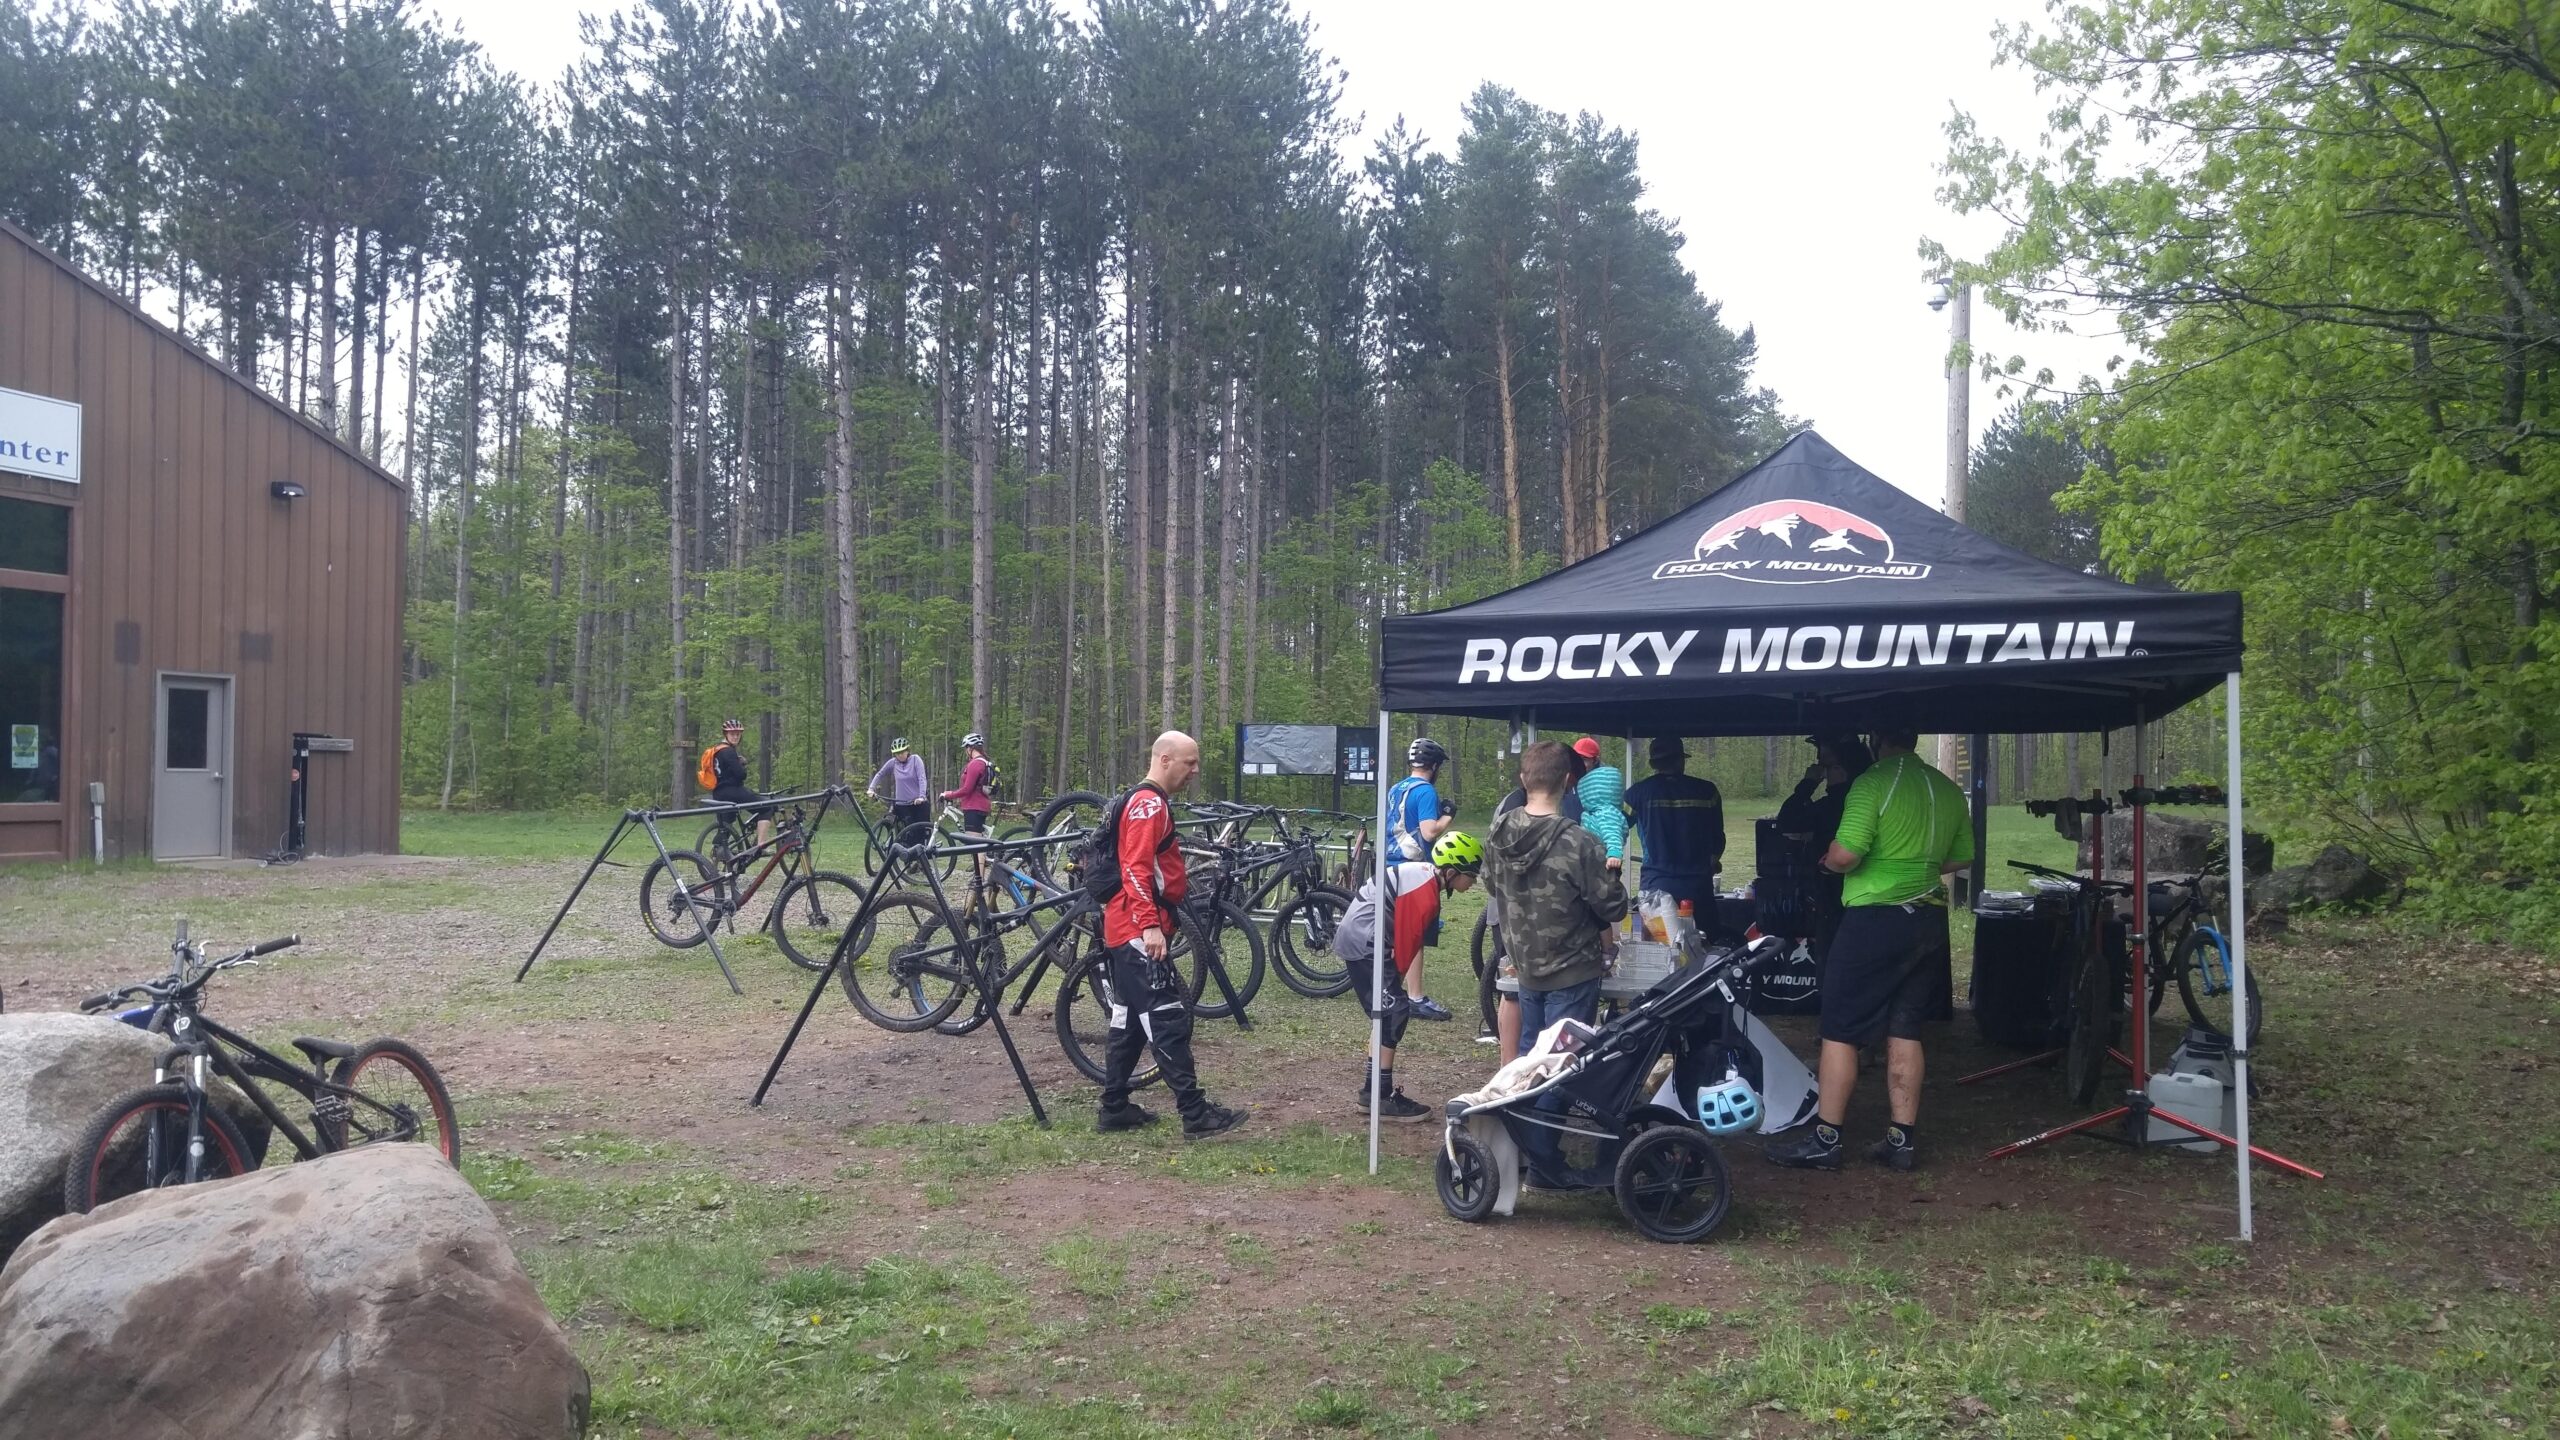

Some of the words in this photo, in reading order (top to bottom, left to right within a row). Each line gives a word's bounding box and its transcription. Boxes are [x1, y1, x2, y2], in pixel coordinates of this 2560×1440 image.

[0, 439, 69, 466] nter
[1666, 560, 1762, 575] ROCKY
[1766, 559, 1917, 576] MOUNTAIN
[1457, 629, 1700, 684] ROCKY
[1717, 620, 2136, 674] MOUNTAIN
[1773, 974, 1817, 986] MOUNT
